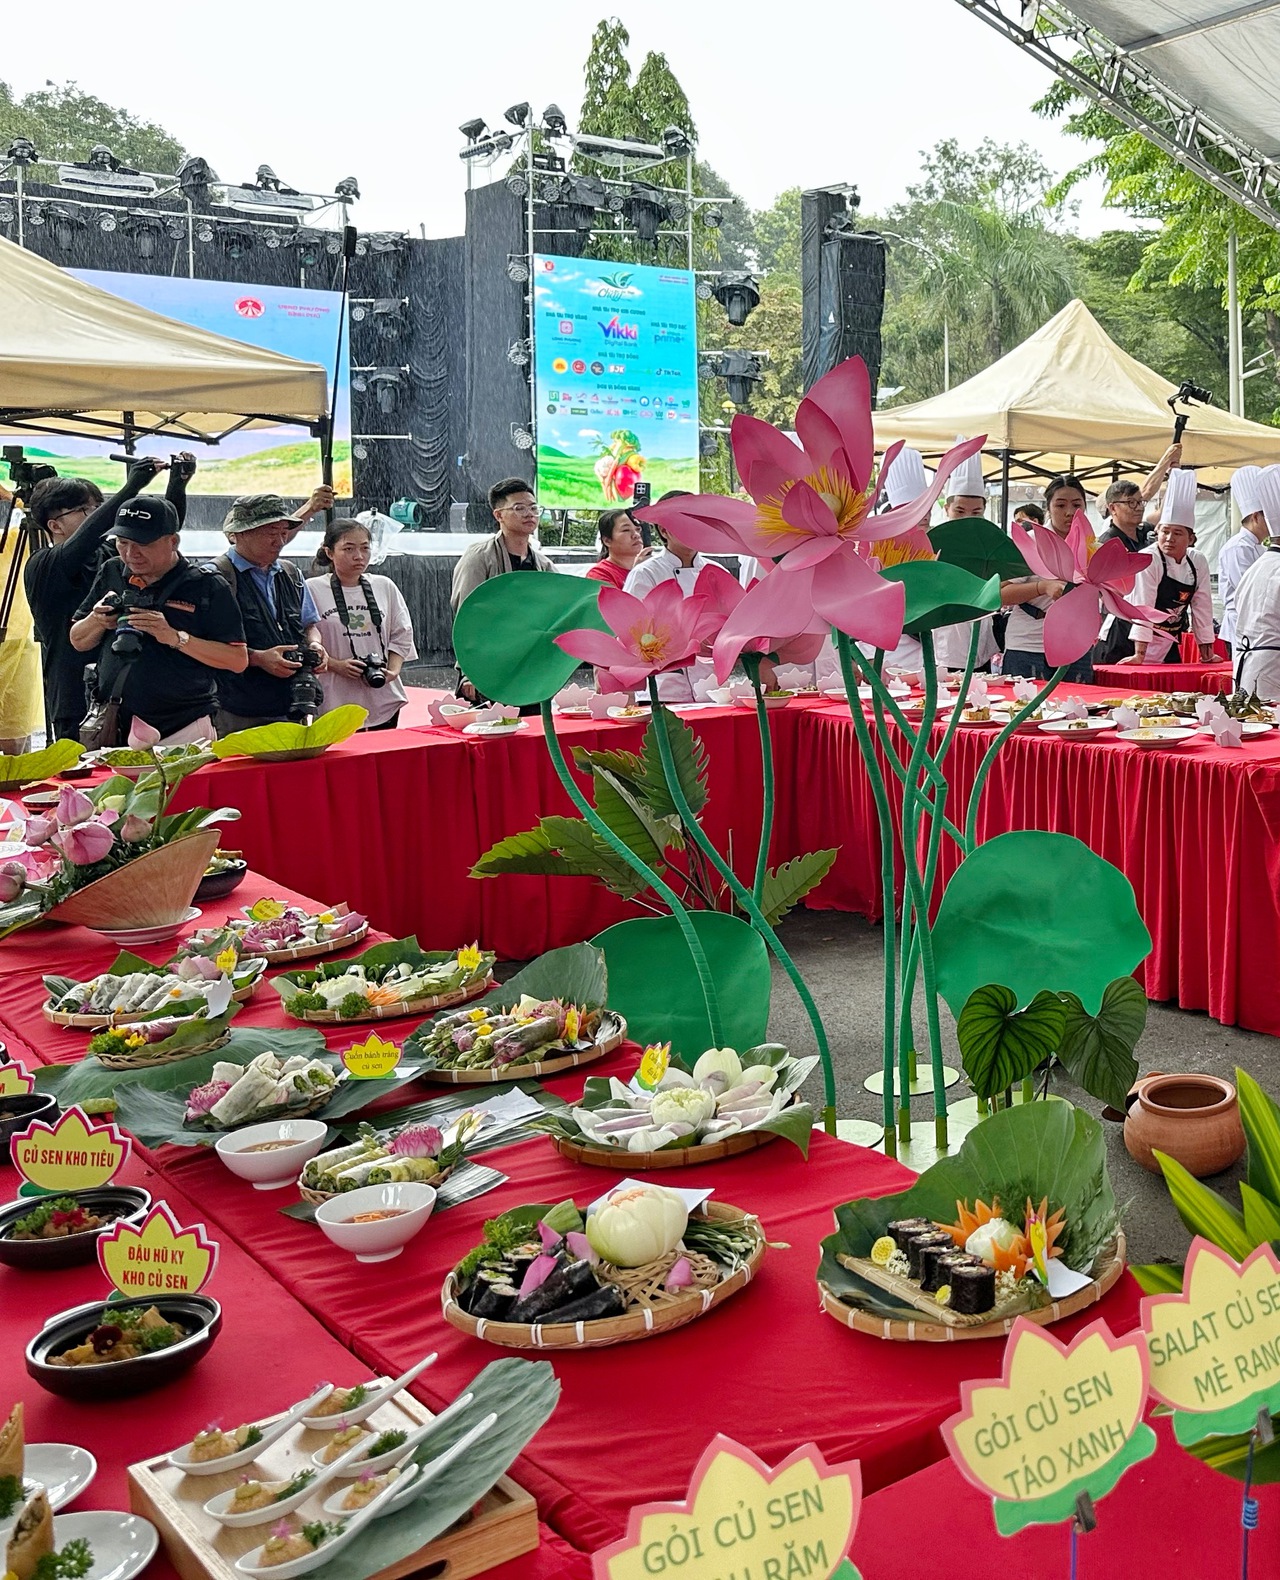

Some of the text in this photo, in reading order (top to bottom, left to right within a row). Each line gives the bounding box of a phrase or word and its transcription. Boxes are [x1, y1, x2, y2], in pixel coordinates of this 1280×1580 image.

[598, 316, 637, 340] Vikki
[119, 508, 151, 520] BYD
[24, 1144, 114, 1167] CỦ SEN KHO TIÊU
[128, 1244, 184, 1264] ĐẬU HŨ KY
[123, 1268, 188, 1290] KHO CỦ SEN
[1149, 1311, 1219, 1366] SALAT
[1225, 1289, 1254, 1330] CỦ
[1194, 1357, 1232, 1402] MÈ
[974, 1371, 1113, 1458] GỎI CỦ SEN
[1004, 1418, 1128, 1498] TÁO XANH
[642, 1484, 824, 1574] GỎI CỦ SEN
[764, 1539, 829, 1580] RĂM
